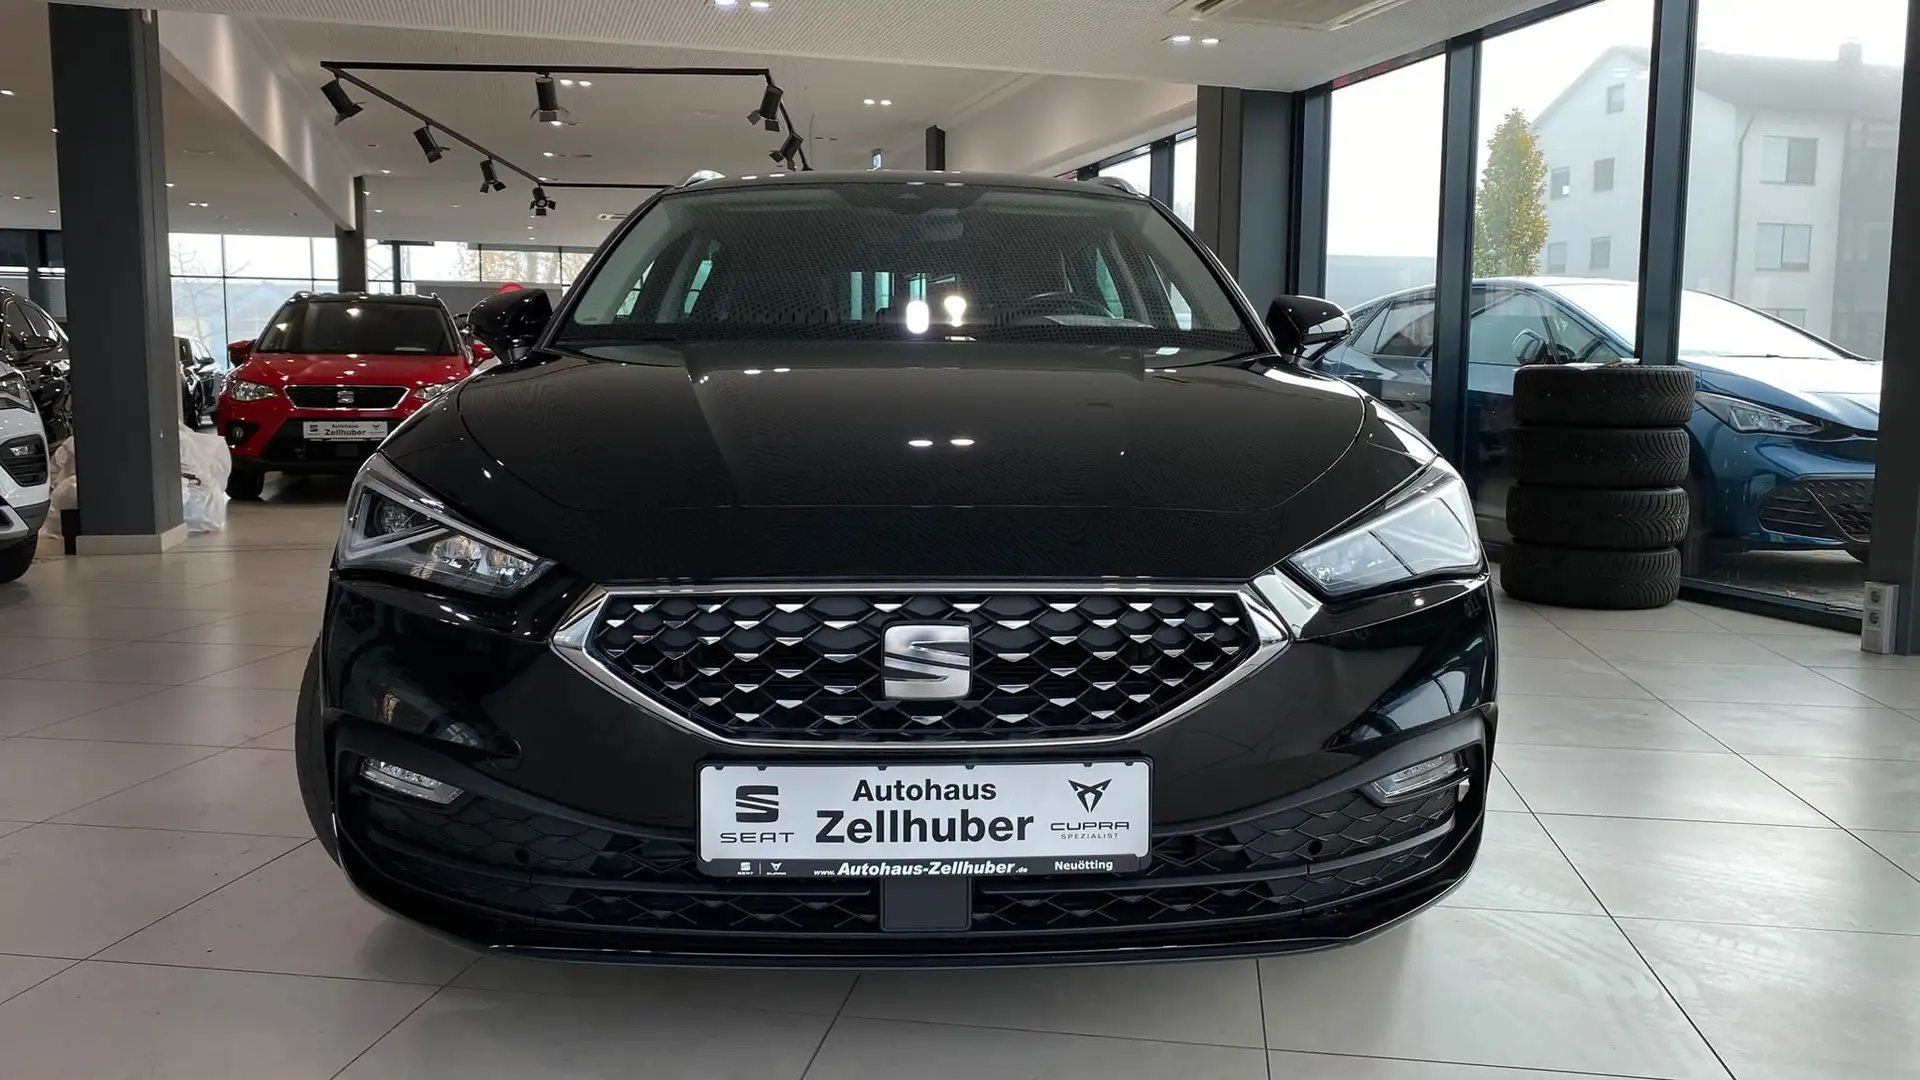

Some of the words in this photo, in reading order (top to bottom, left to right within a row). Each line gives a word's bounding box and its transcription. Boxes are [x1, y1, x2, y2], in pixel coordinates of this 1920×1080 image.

[852, 779, 997, 801] Autohaus
[815, 809, 1035, 844] Zellhuber
[1050, 821, 1130, 831] CUPRA
[720, 832, 794, 844] SEAT
[1054, 860, 1114, 871] Neuötting
